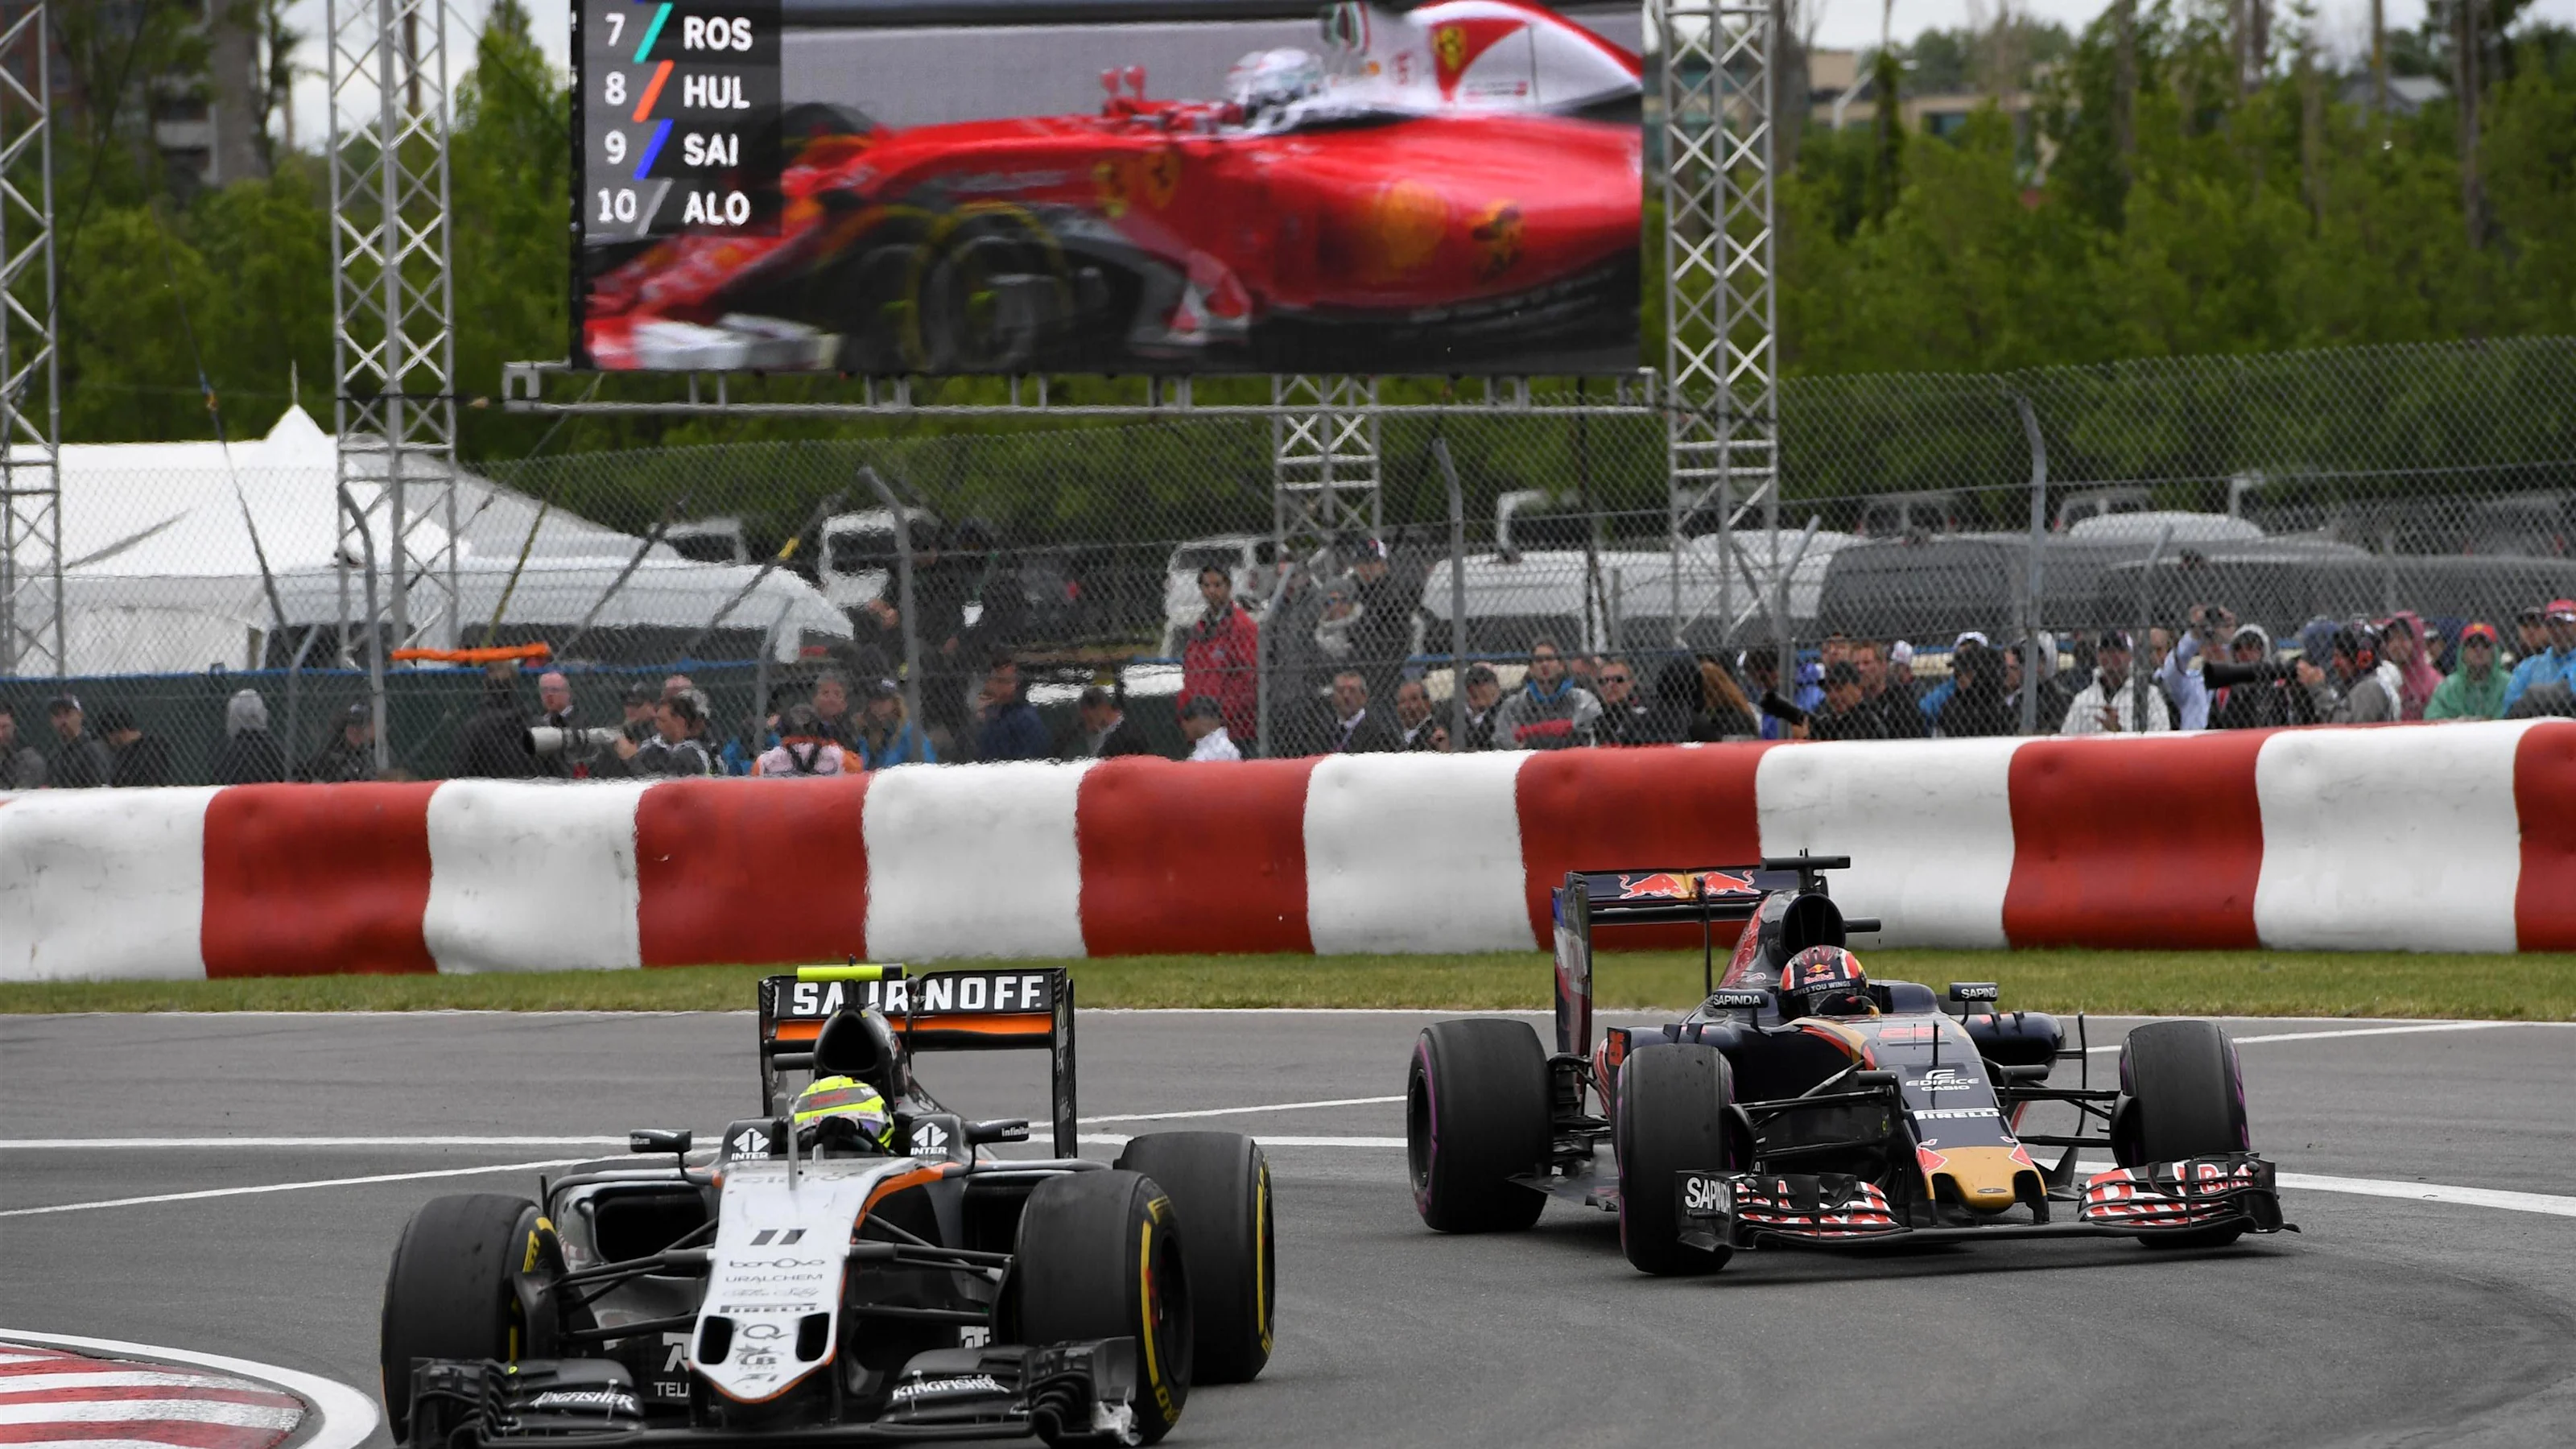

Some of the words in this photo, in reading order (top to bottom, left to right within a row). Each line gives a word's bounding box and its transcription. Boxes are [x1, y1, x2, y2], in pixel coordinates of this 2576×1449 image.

[605, 13, 625, 47] 7
[683, 15, 753, 52] ROS
[605, 71, 627, 105] 8
[683, 75, 751, 109] HUL
[605, 130, 626, 165] 9
[683, 132, 740, 167] SAI
[598, 188, 637, 223] 10
[683, 190, 751, 226] ALO
[1810, 983, 1827, 992] YOU
[1828, 980, 1852, 989] WINGS
[1712, 994, 1761, 1005] SAPINDA
[1905, 1078, 1979, 1087] EDIFICE
[1913, 1108, 2000, 1121] PIRELLI
[731, 1152, 769, 1161] INTER
[910, 1146, 948, 1156] INTER
[1684, 1176, 1731, 1216] SAPINDA
[749, 1228, 808, 1246] 11
[725, 1273, 824, 1284] URALCHEM
[654, 1381, 691, 1397] TEL
[892, 1373, 1012, 1402] KINGFISHER
[529, 1391, 637, 1414] KINGFISHER
